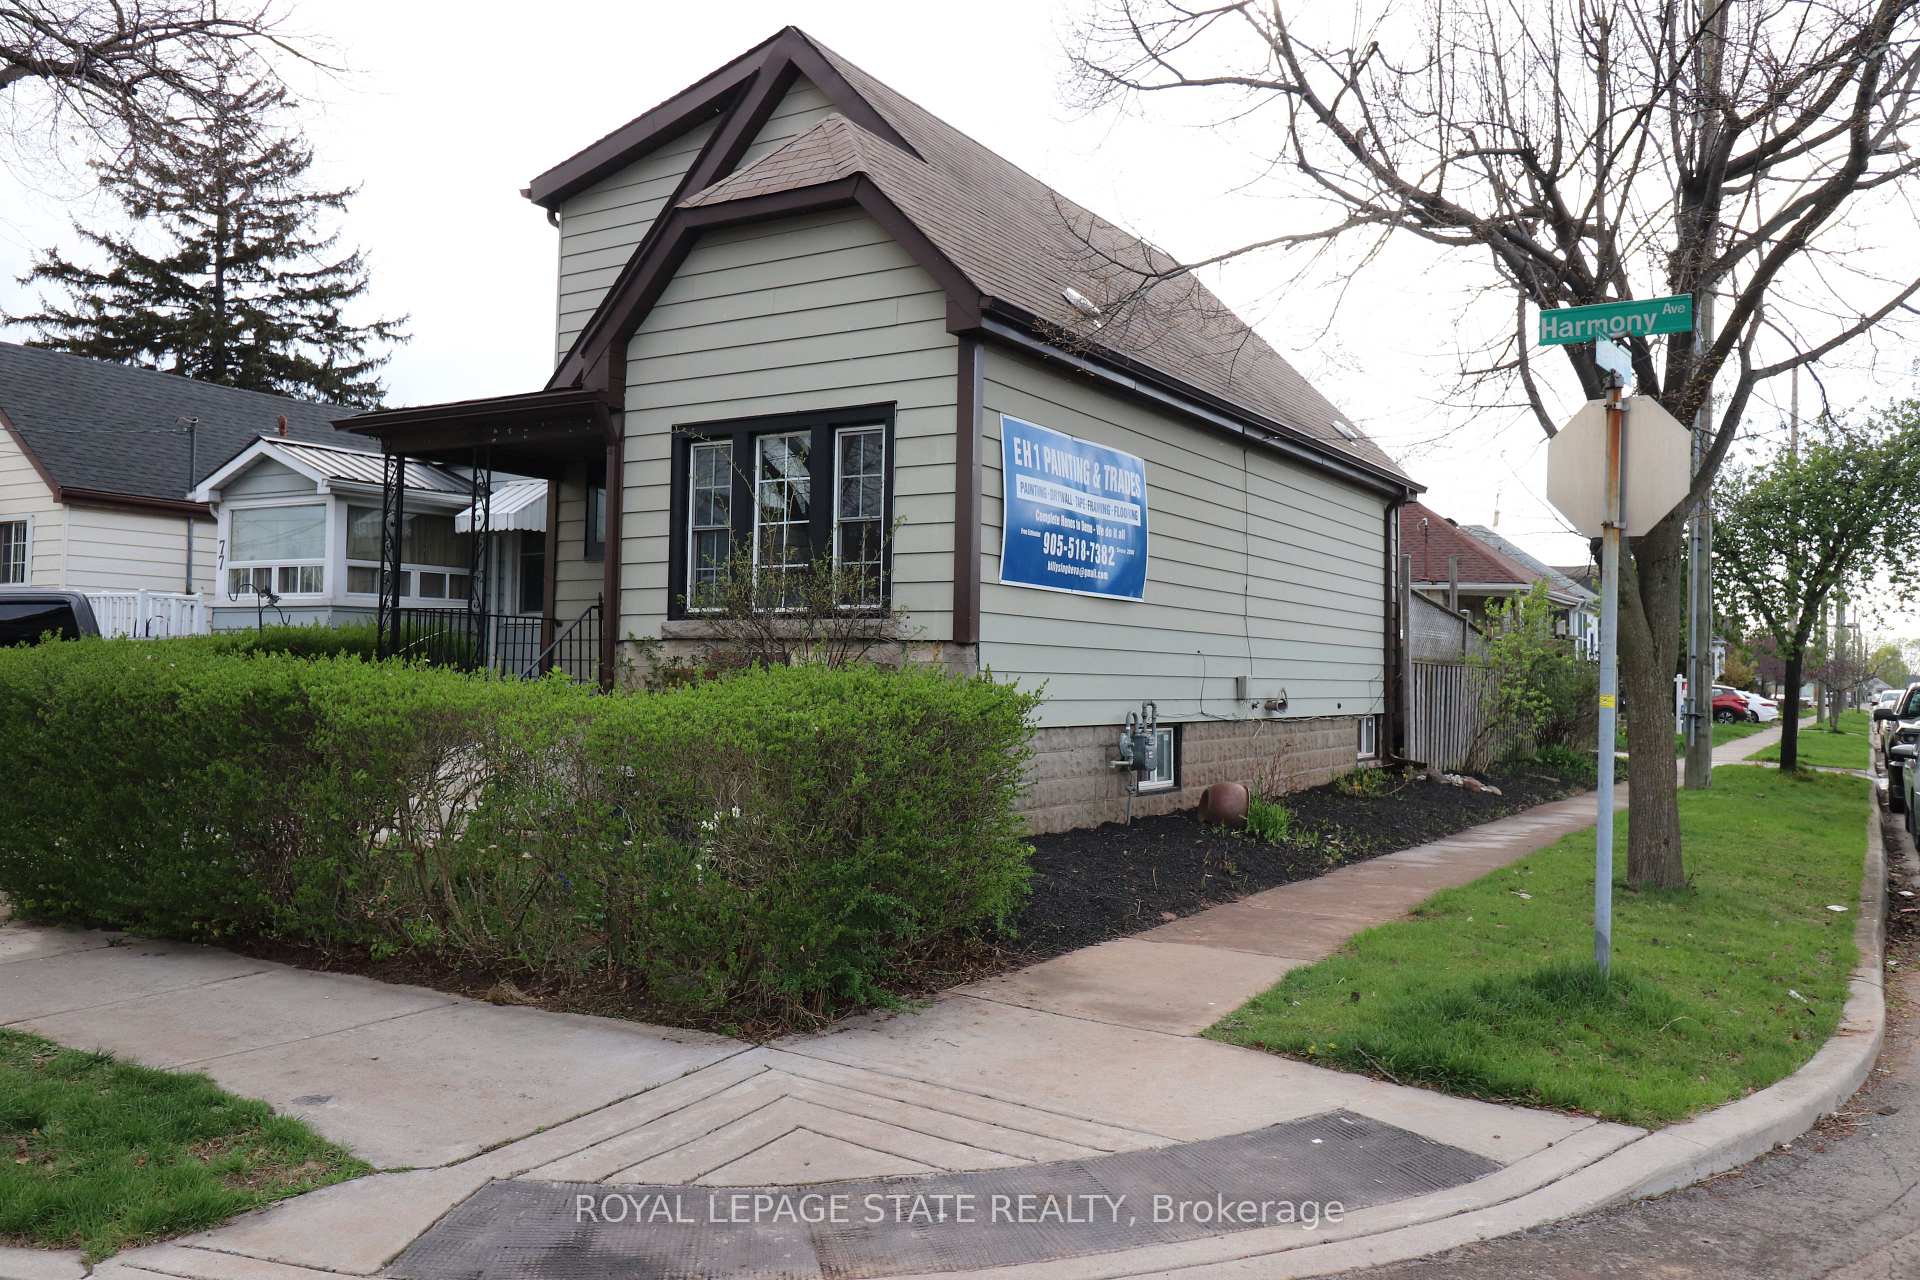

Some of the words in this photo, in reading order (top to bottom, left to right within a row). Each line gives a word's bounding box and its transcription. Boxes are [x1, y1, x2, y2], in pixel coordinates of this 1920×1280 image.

[1541, 312, 1657, 340] Harmony
[1662, 302, 1686, 315] Ave
[1043, 446, 1090, 488] PAINTING
[1093, 461, 1101, 489] &
[1103, 464, 1141, 498] TRADES
